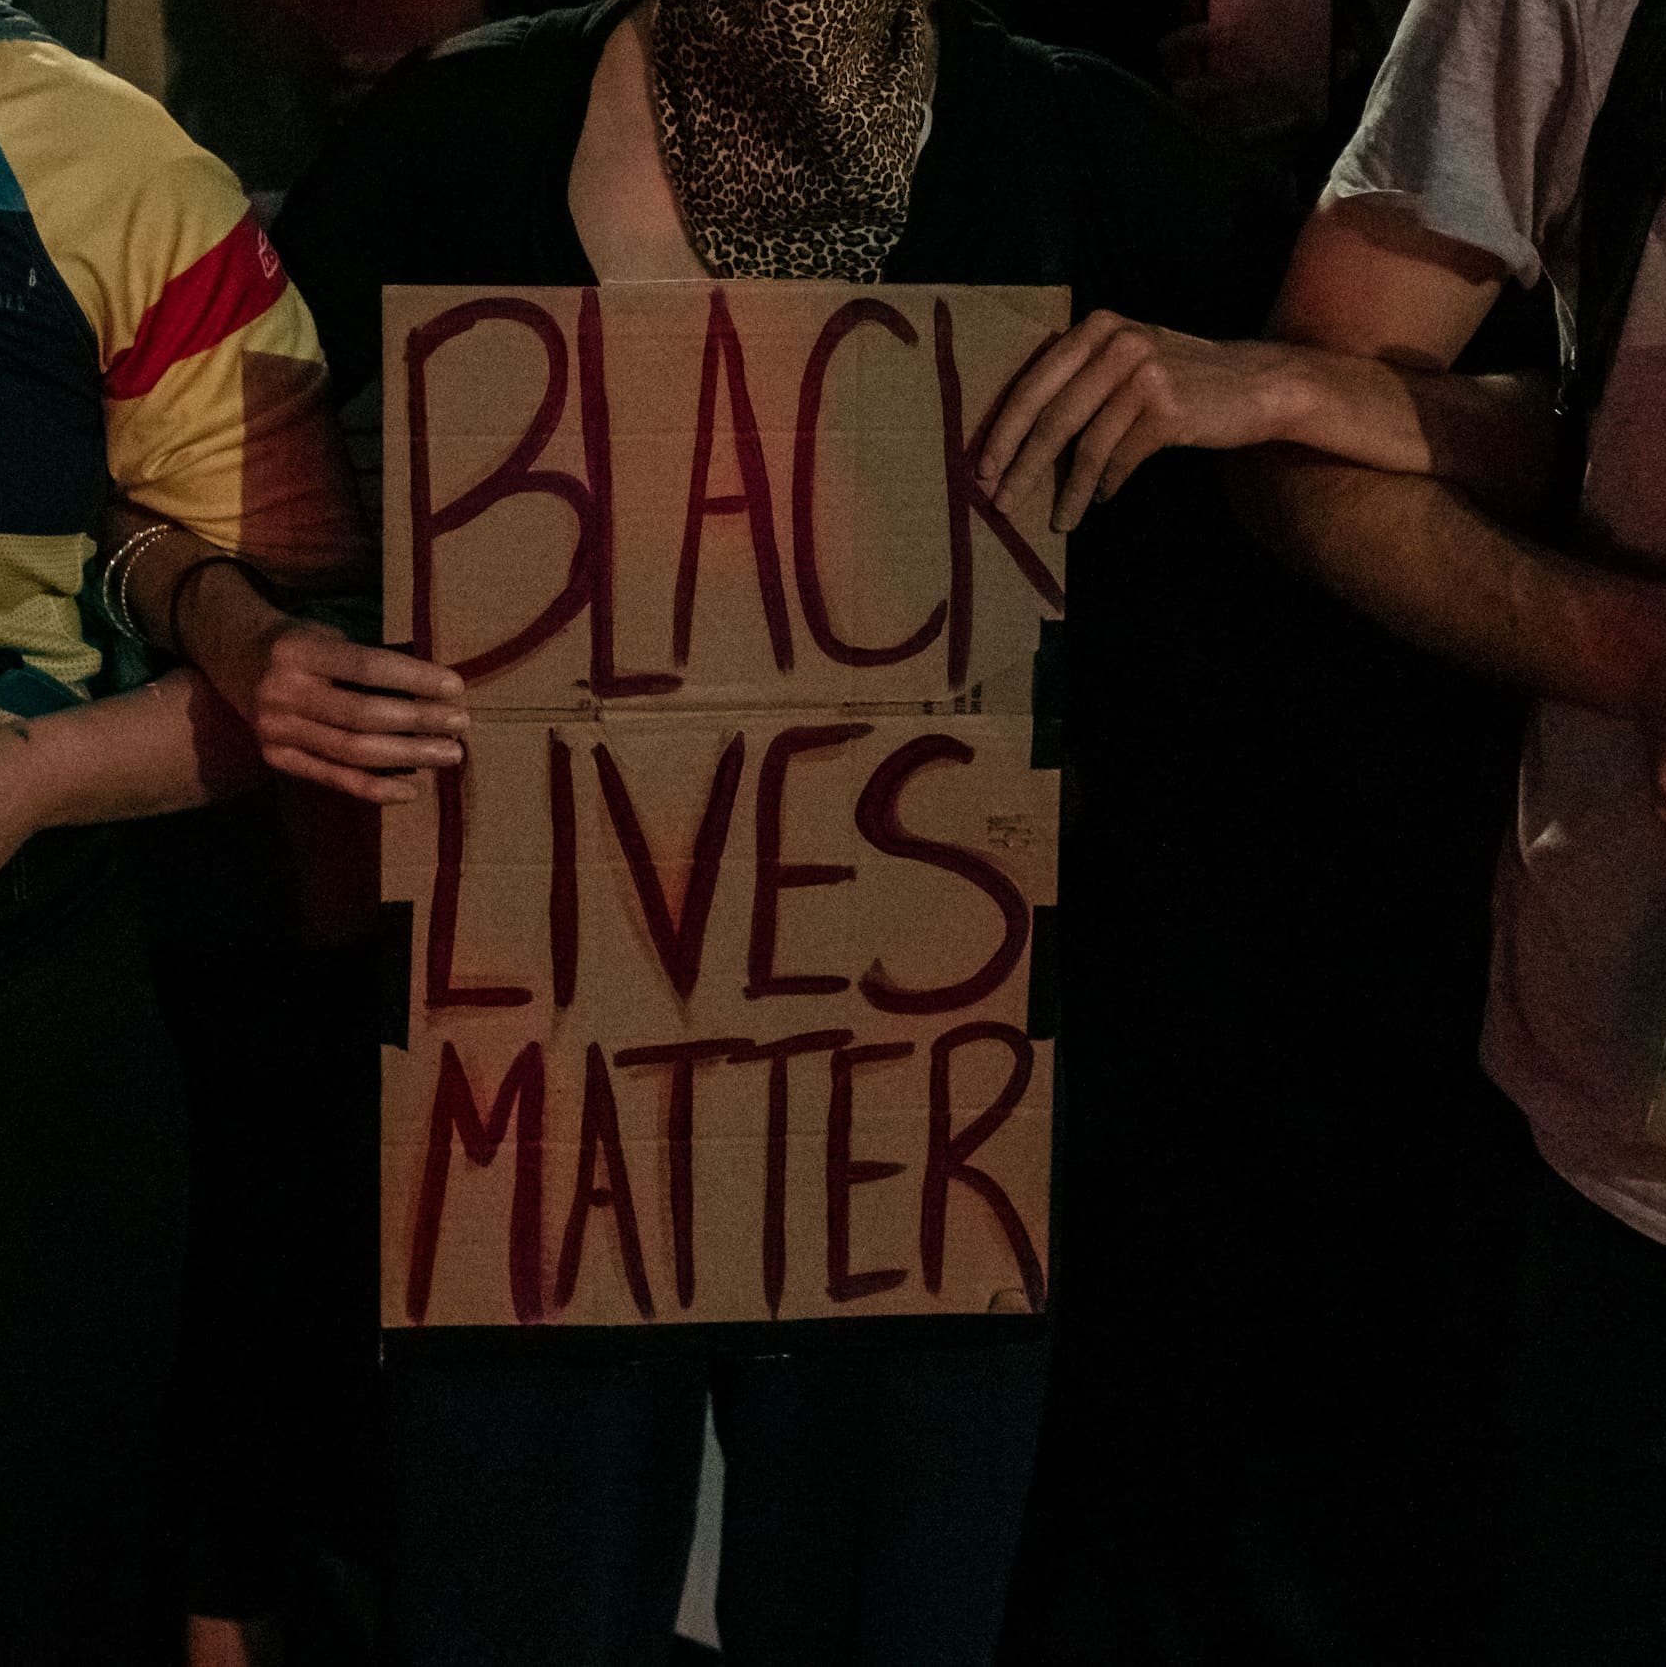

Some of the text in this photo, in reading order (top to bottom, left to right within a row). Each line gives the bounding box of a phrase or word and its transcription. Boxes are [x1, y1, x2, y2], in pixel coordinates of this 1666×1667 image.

[406, 287, 1065, 698] BLACK
[426, 723, 1031, 1014] LIVES
[405, 1019, 1045, 1325] MATTER
